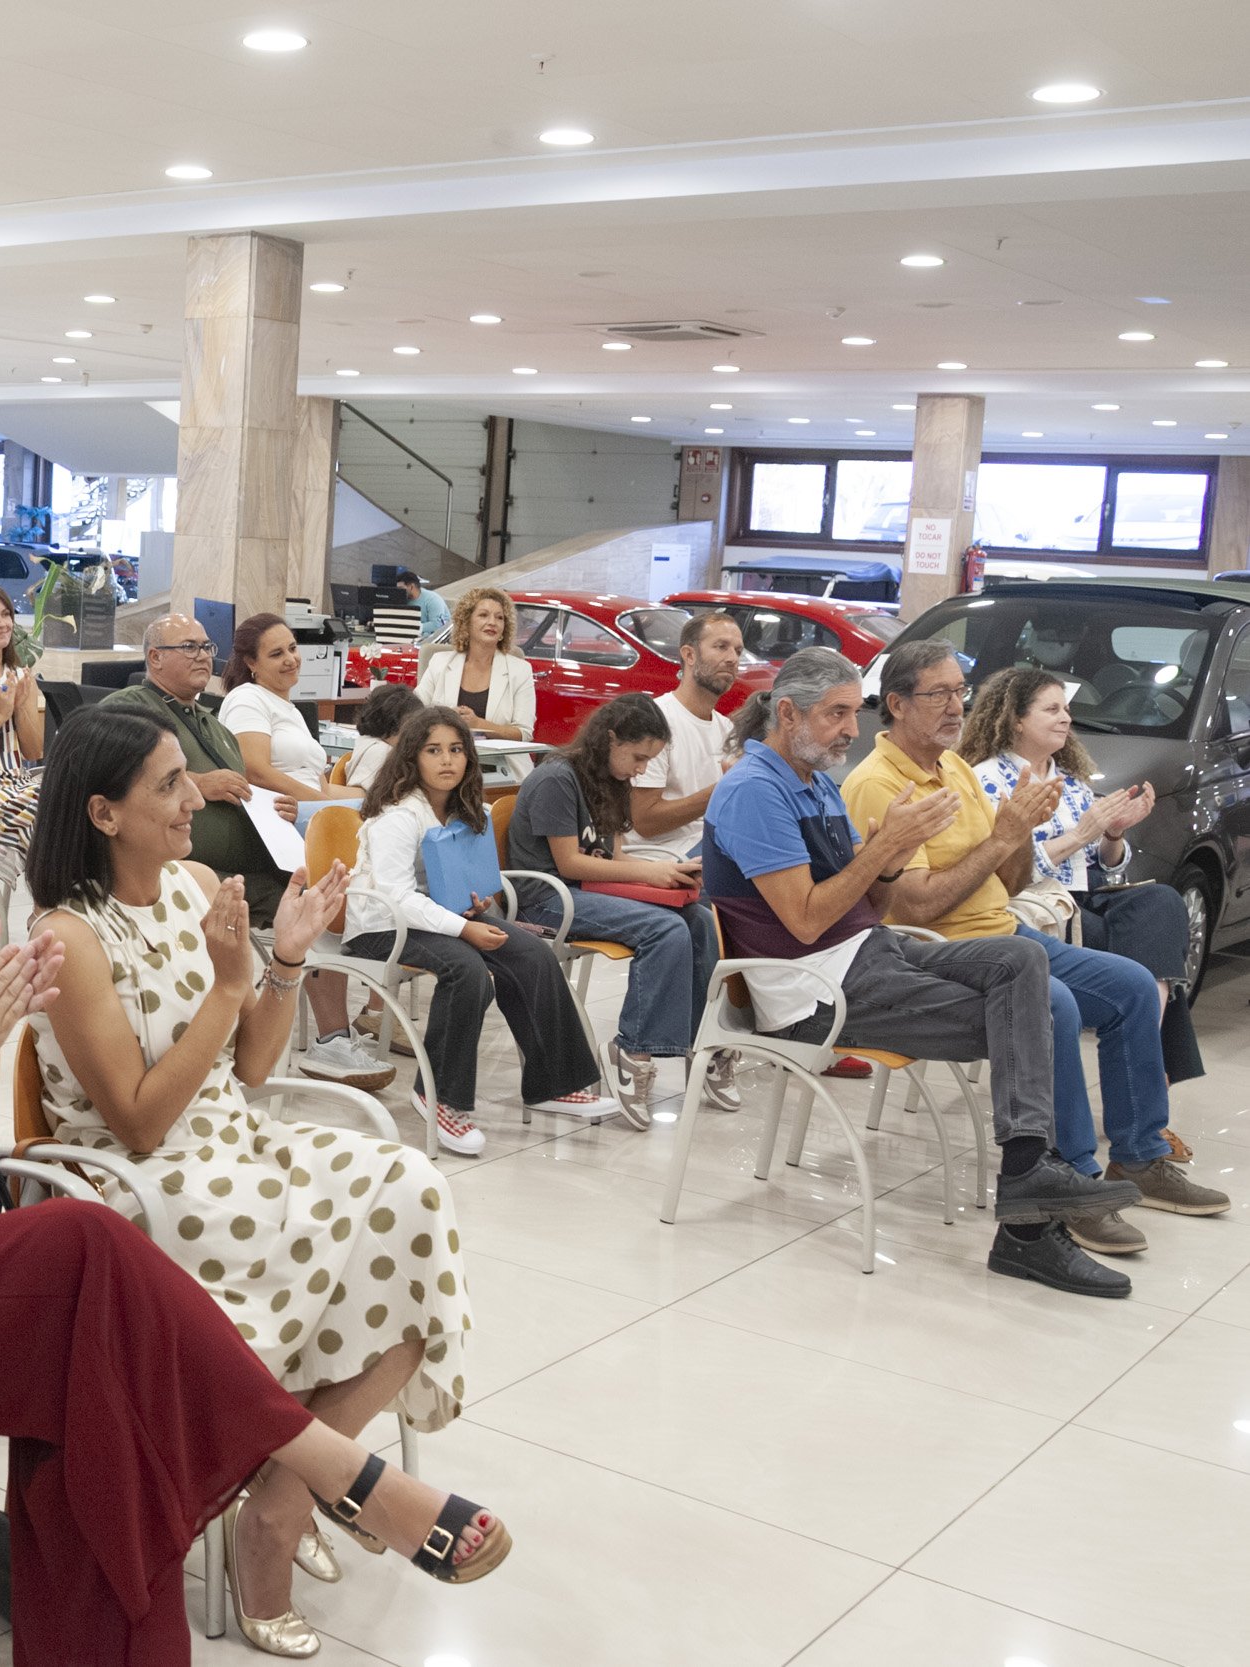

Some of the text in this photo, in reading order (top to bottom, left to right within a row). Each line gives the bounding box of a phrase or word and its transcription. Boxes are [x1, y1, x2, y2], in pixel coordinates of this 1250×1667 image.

[925, 523, 936, 531] NO
[918, 532, 942, 541] TOCAR
[915, 551, 941, 560] DO NOT
[916, 561, 940, 569] TOUCH
